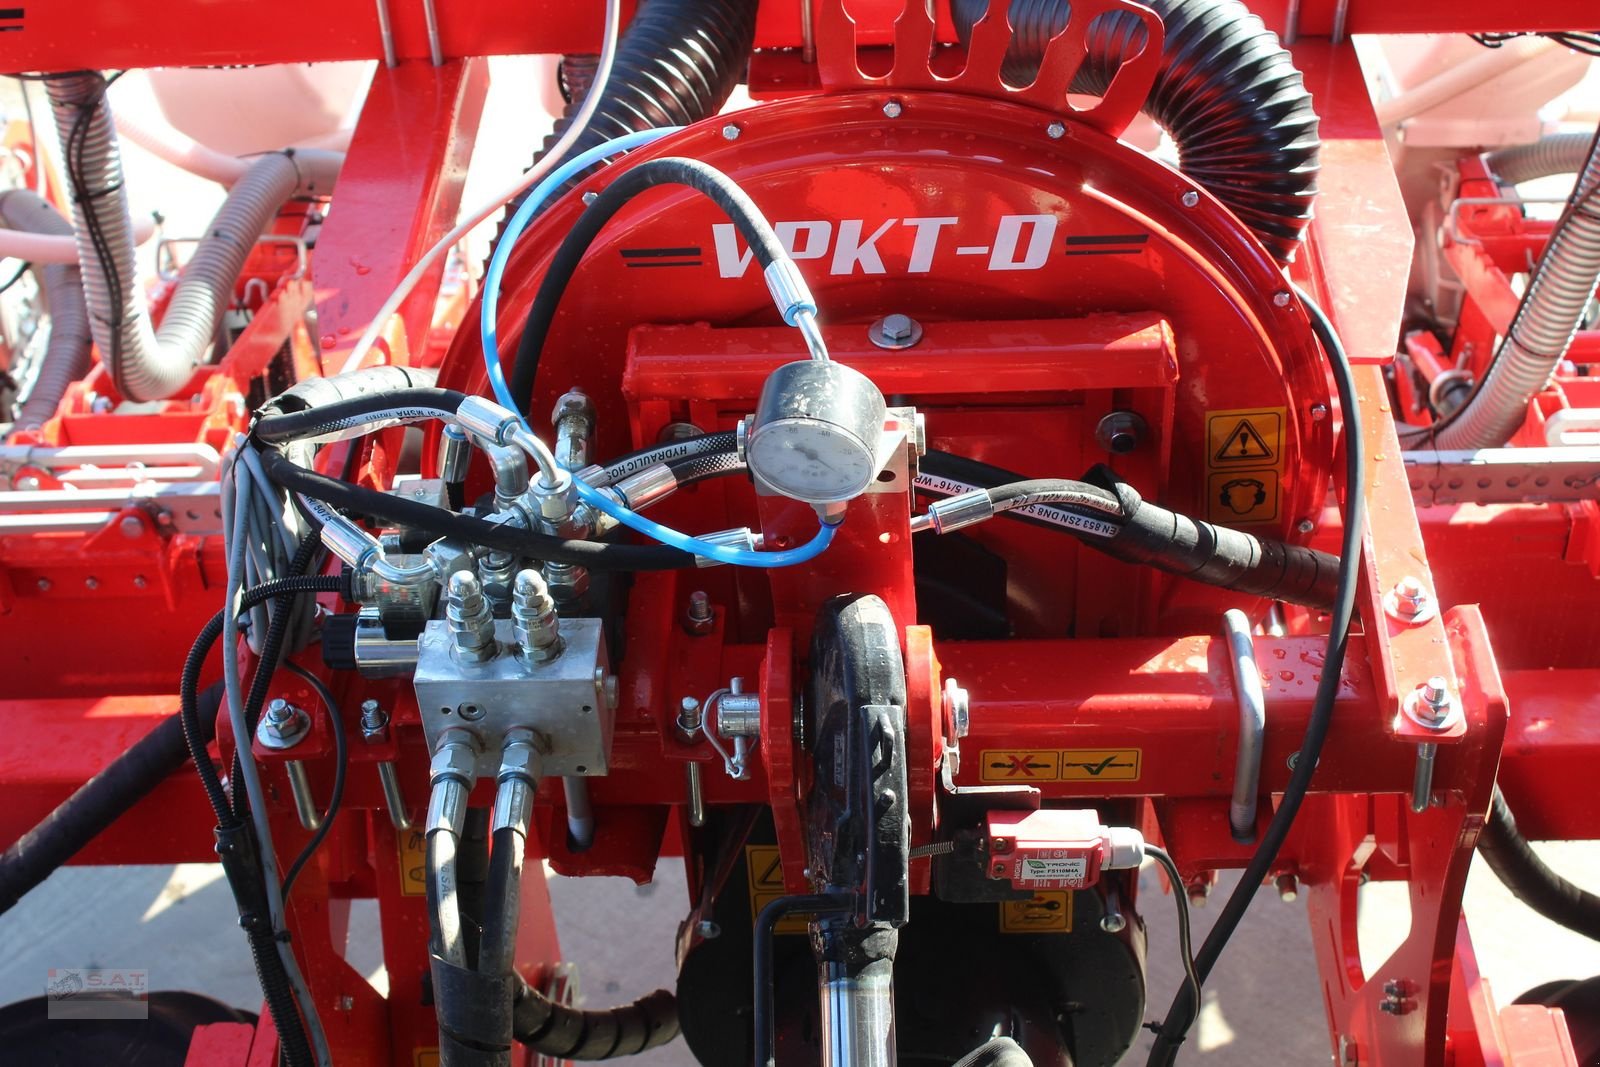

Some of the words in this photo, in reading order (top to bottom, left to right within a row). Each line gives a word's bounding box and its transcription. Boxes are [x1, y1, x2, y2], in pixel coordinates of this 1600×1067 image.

[711, 213, 1058, 279] VPKT-D
[627, 445, 687, 468] HYDRAULIC
[1037, 507, 1060, 521] DN8
[1060, 513, 1082, 528] 2SN
[1082, 519, 1101, 532] 853
[1101, 524, 1118, 536] EN
